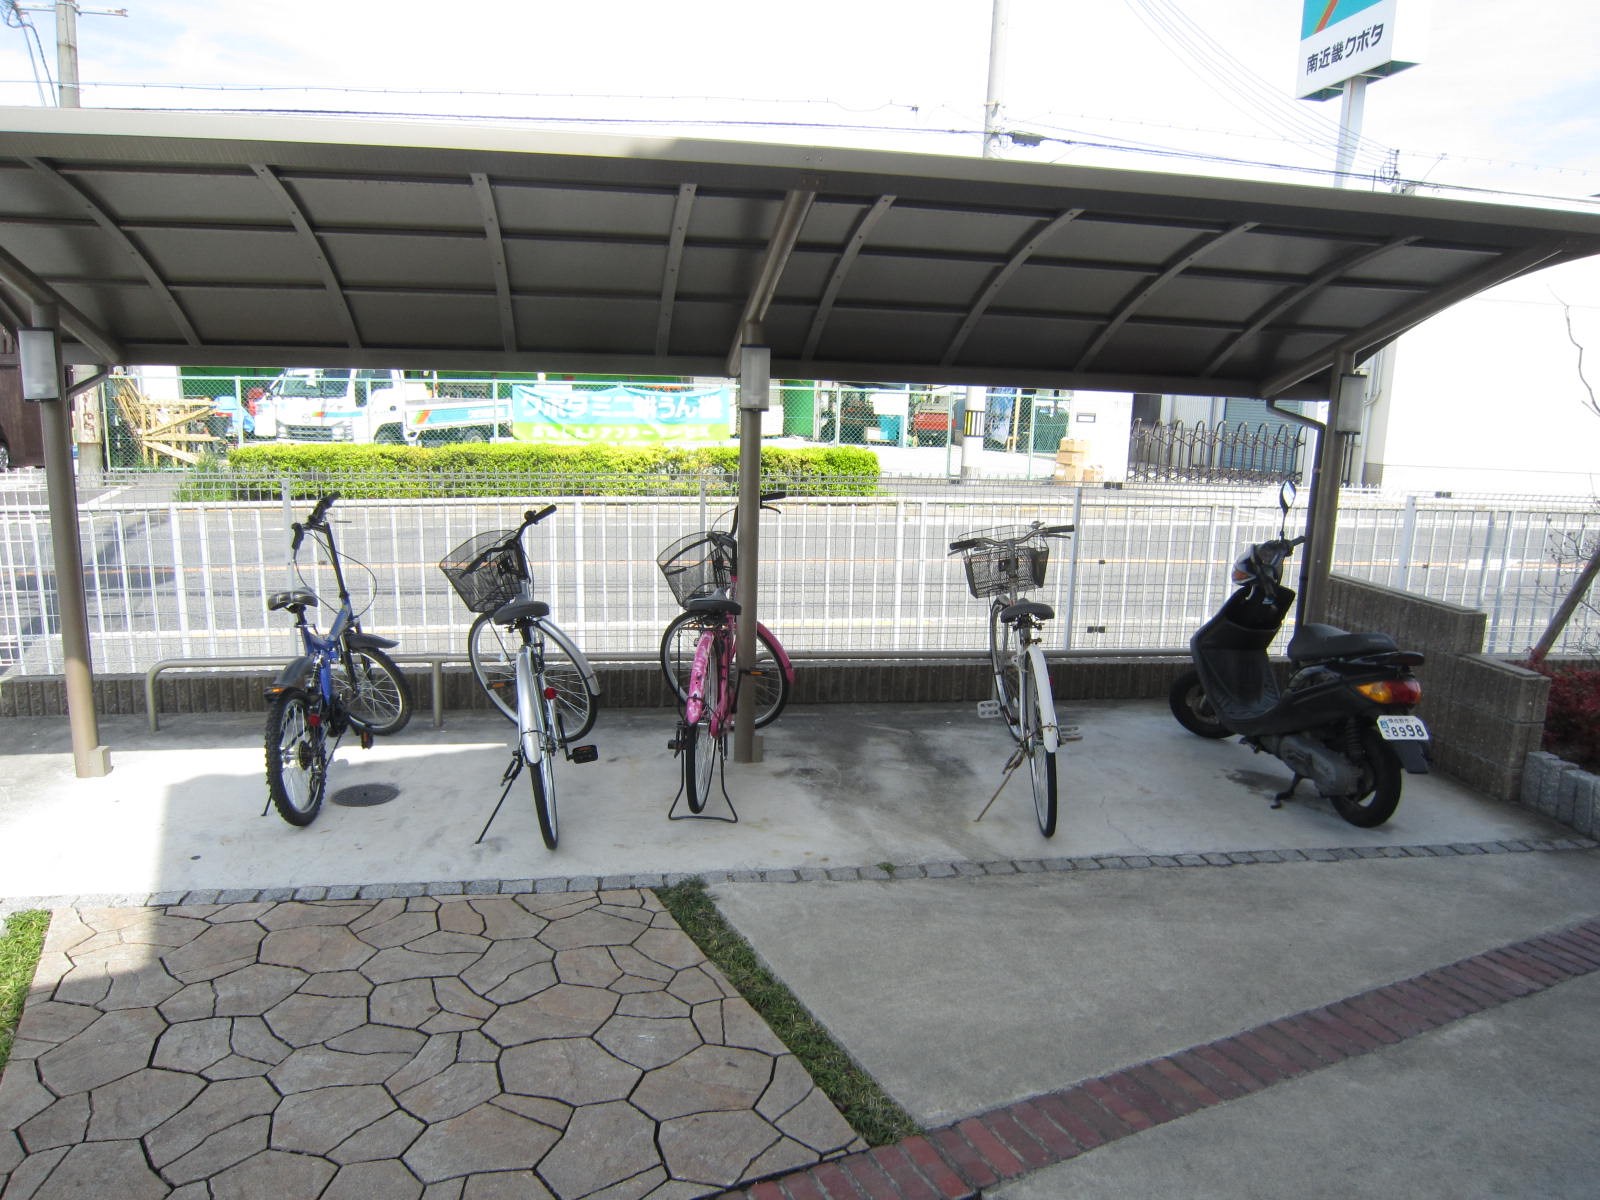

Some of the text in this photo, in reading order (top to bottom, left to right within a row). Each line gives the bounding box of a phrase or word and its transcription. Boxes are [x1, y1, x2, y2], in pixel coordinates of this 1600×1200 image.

[1306, 23, 1384, 76] 南近畿クボタ
[1391, 724, 1424, 737] 8998
